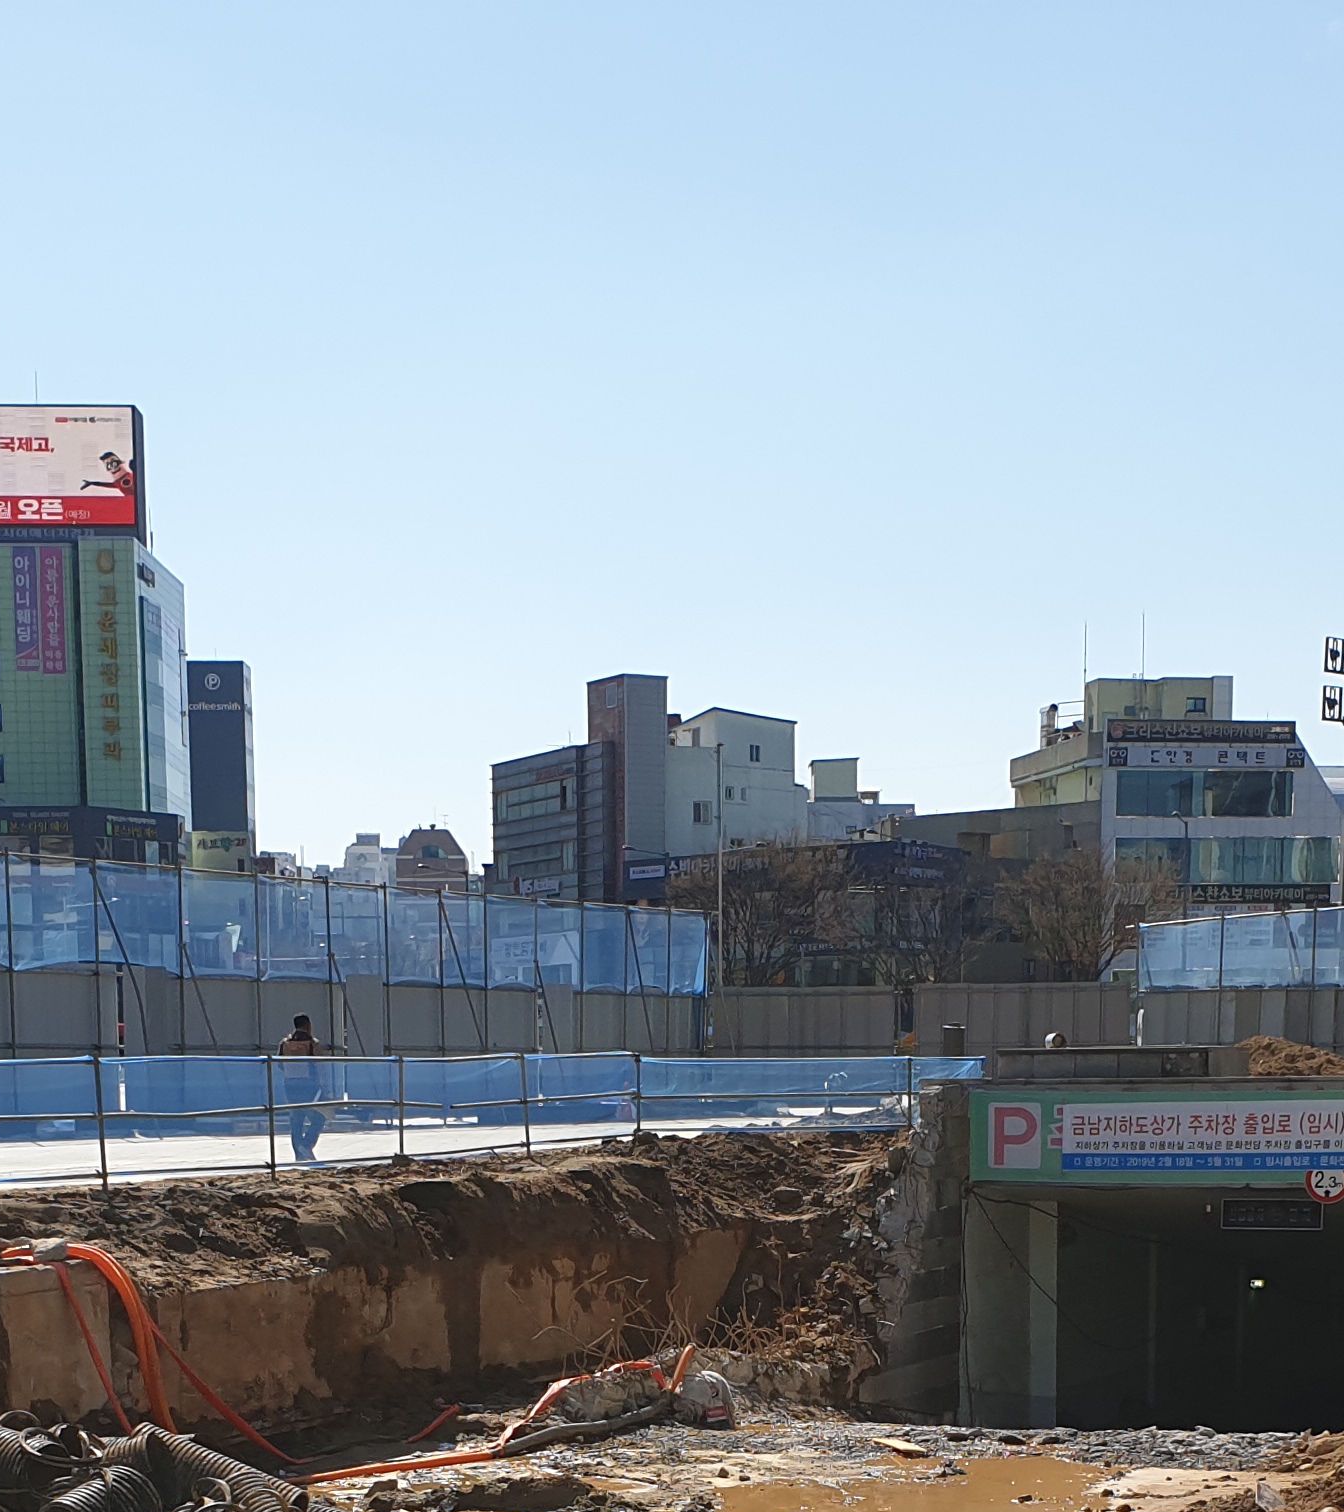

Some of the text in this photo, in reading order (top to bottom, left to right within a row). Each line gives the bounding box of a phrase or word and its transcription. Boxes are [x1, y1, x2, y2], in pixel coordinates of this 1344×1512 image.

[14, 555, 31, 642] 아이니웨딩
[188, 701, 241, 711] coffeesmith
[1071, 1115, 1181, 1136] 금남지하도상가
[1188, 1114, 1237, 1135] 주차장
[1243, 1113, 1292, 1135] 출입로
[993, 1106, 1038, 1165] P
[1112, 1141, 1147, 1151] 주차장을
[1225, 1140, 1261, 1150] 문화전당
[1264, 1140, 1292, 1150] 주차장
[1294, 1139, 1331, 1150] 출입구를
[1126, 1156, 1155, 1167] 2019년
[1158, 1156, 1172, 1167] 2월
[1207, 1156, 1222, 1167] 5월
[1224, 1156, 1243, 1166] 31일
[1314, 1170, 1343, 1189] 2.3m
